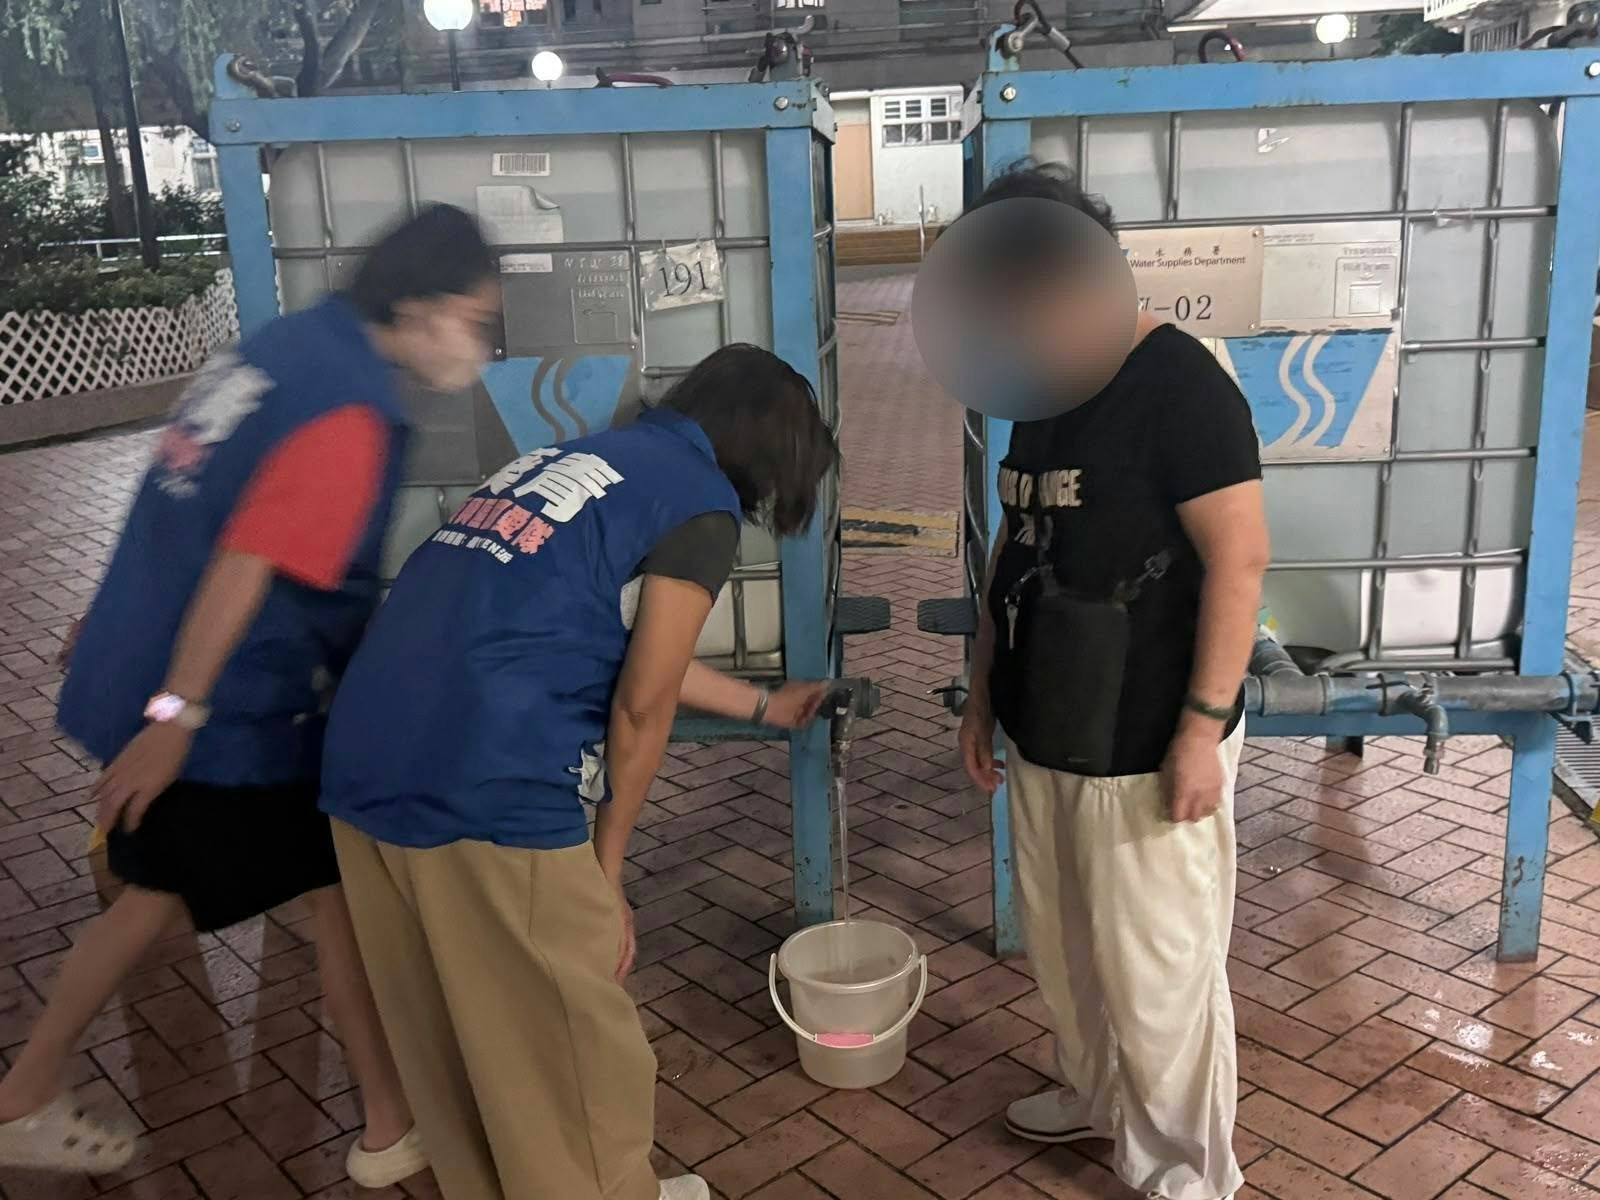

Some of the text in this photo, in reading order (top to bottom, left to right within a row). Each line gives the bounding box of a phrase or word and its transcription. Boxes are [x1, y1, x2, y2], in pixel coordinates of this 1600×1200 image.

[1130, 256, 1246, 269] Water Supplies Department
[658, 261, 710, 298] 191
